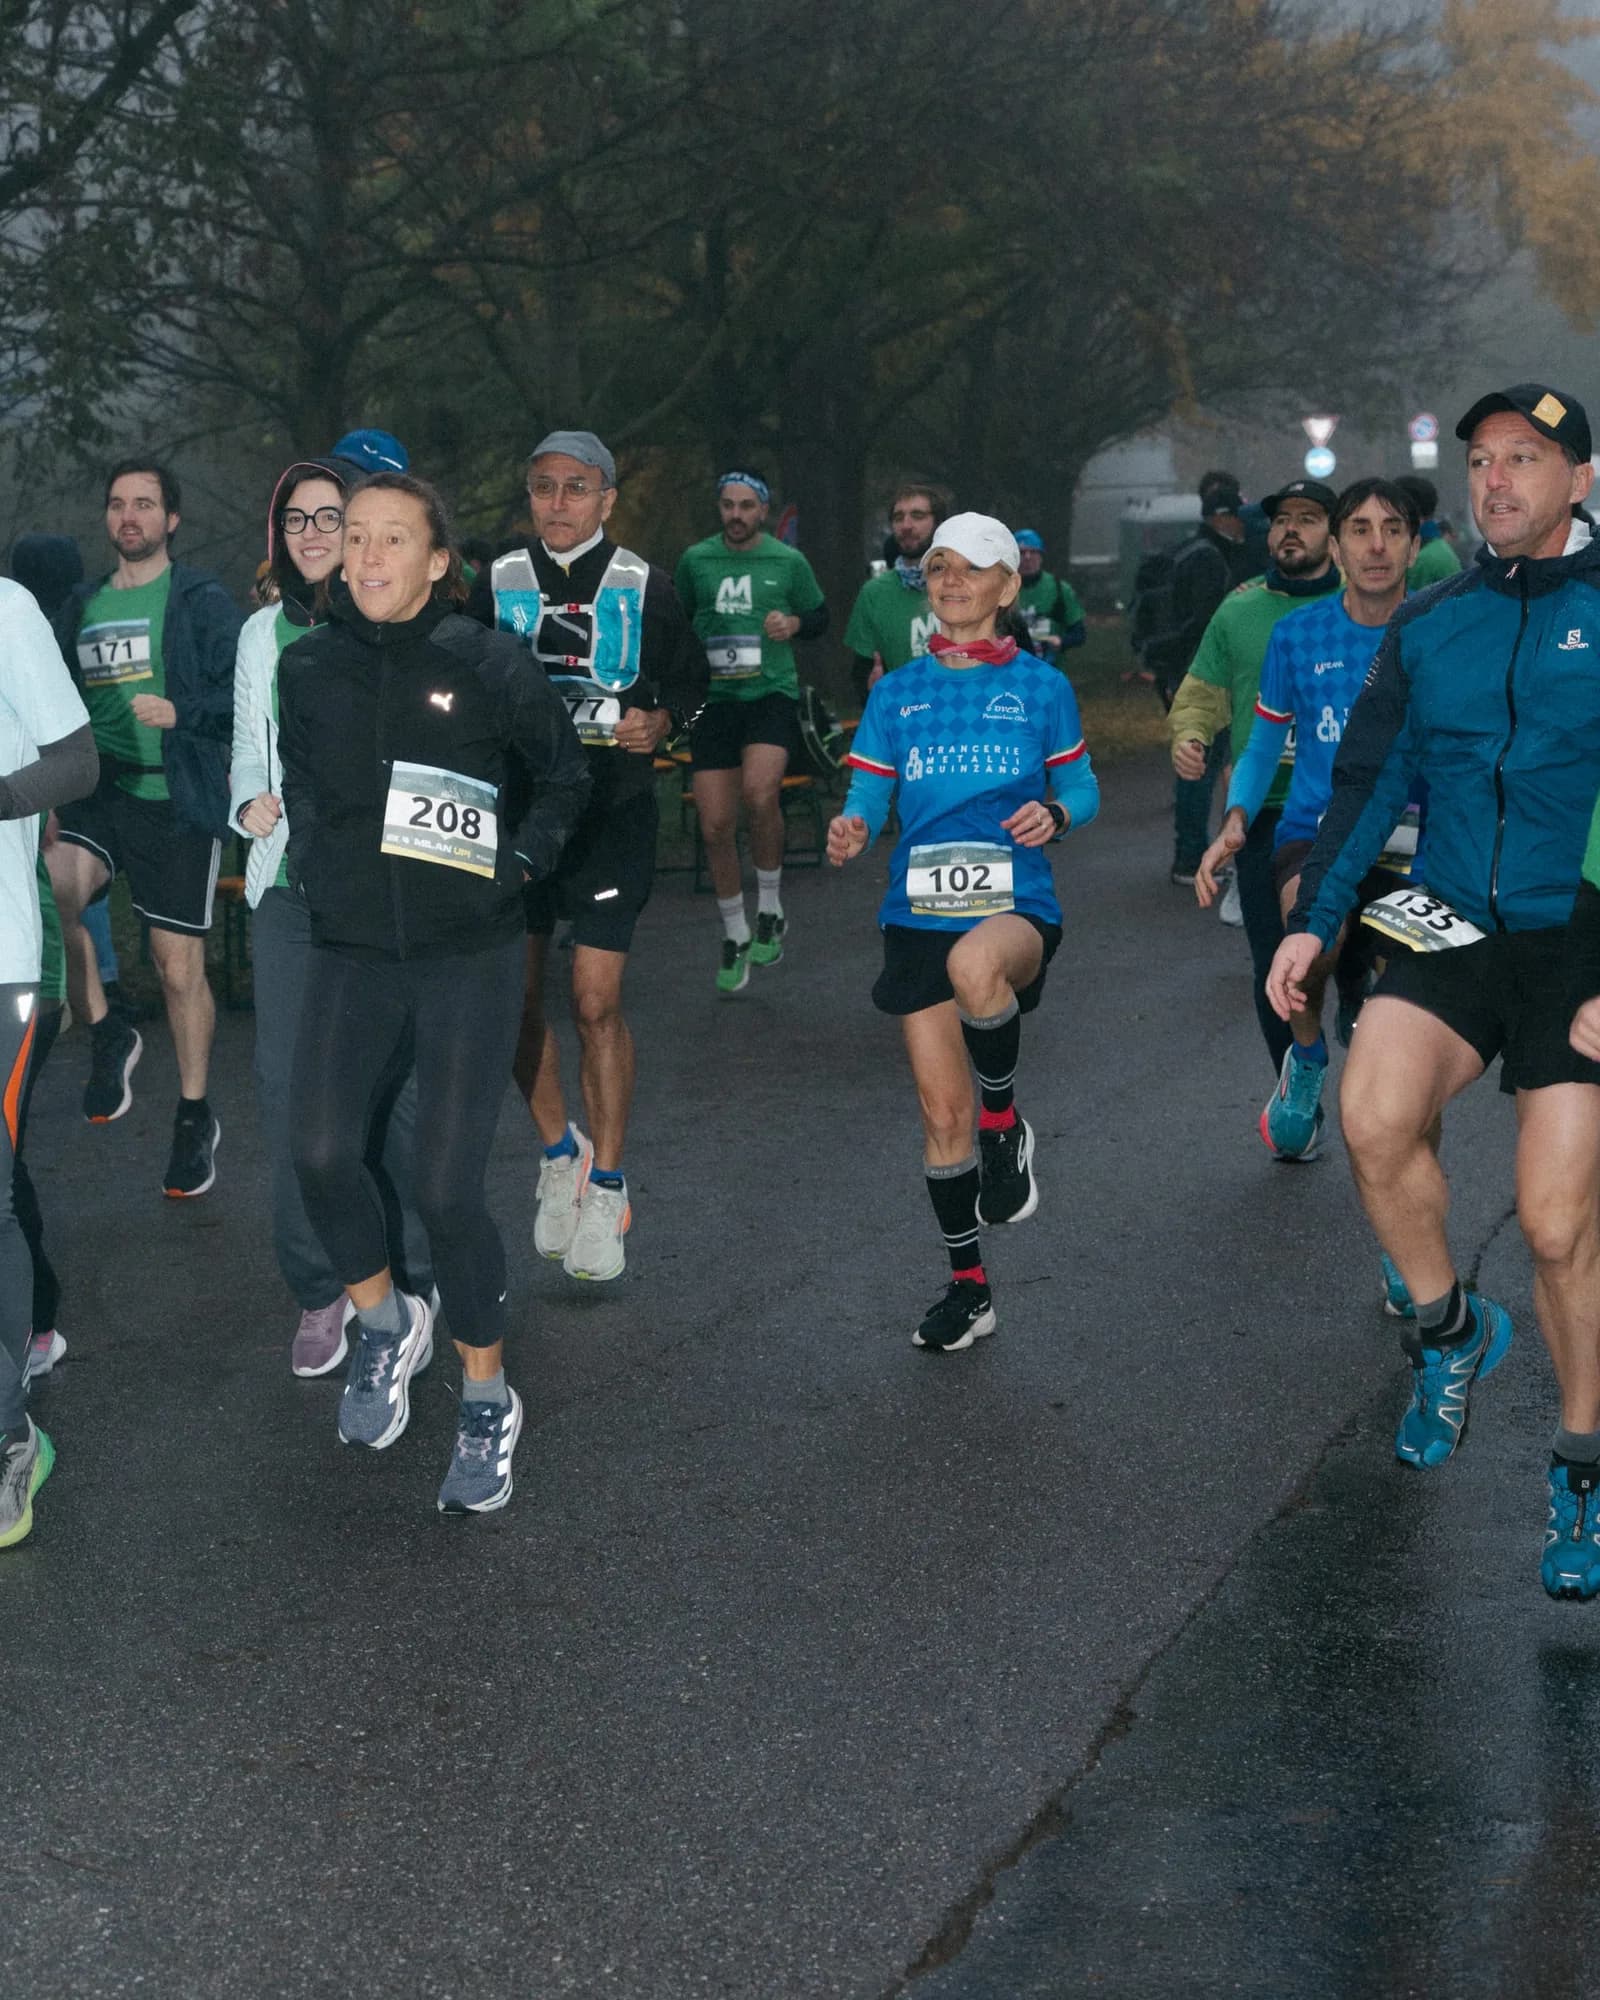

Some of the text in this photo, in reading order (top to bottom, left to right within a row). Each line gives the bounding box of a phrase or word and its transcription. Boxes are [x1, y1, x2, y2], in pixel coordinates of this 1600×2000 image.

[92, 640, 132, 664] 171
[726, 650, 737, 663] 9
[928, 745, 1020, 755] TRANCERIE
[926, 755, 1020, 765] METALLI
[925, 765, 1020, 775] QUINZANO
[409, 796, 481, 839] 208
[414, 838, 452, 853] MILAN
[929, 865, 992, 893] 102
[935, 900, 969, 908] MILAN
[1396, 895, 1466, 931] 135
